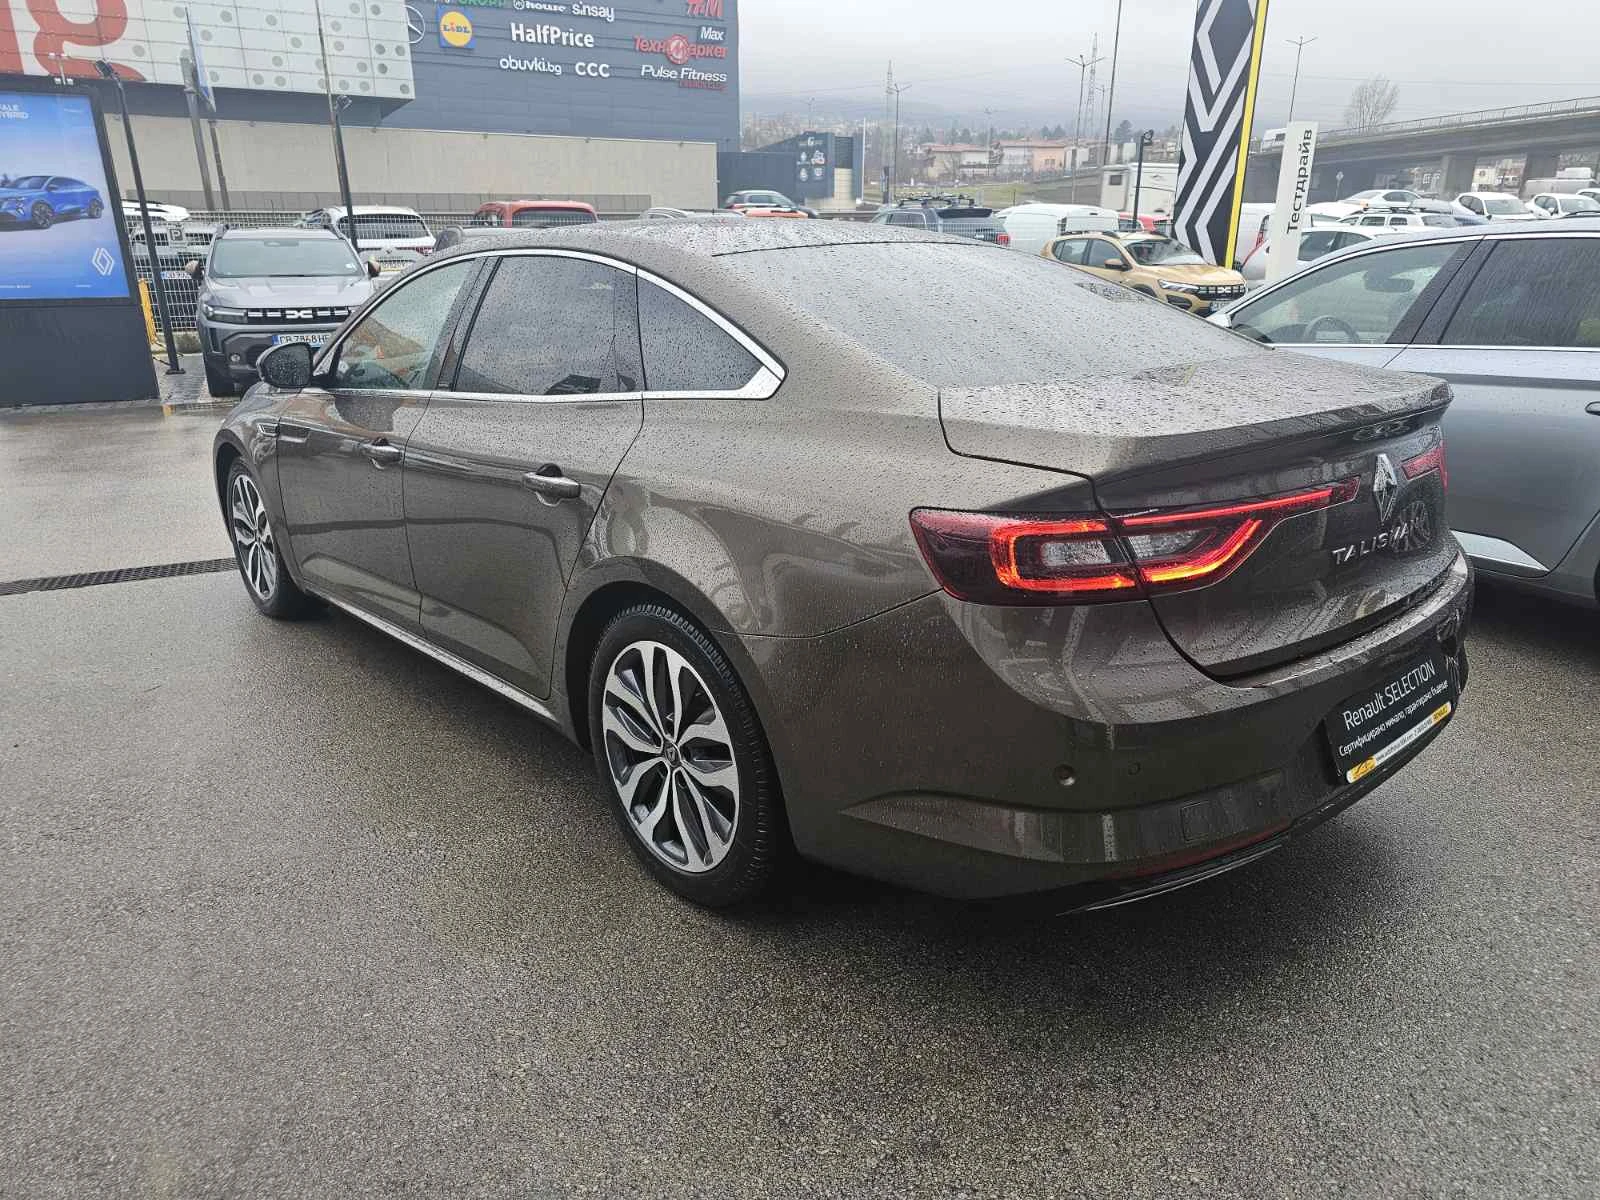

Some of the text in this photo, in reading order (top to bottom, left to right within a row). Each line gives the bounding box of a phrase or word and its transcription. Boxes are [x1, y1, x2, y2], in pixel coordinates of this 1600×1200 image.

[572, 1, 615, 22] sinsay
[510, 22, 594, 48] HalfPrice
[700, 26, 725, 41] Max
[499, 54, 562, 75] obuvki.bg
[574, 61, 610, 78] CCC
[640, 64, 727, 82] Pulse Fitness
[1286, 129, 1313, 234] Тестдрайв
[1342, 691, 1387, 731] Renault
[1384, 659, 1436, 705] SELECTION
[1339, 723, 1386, 757] Сертифицирано
